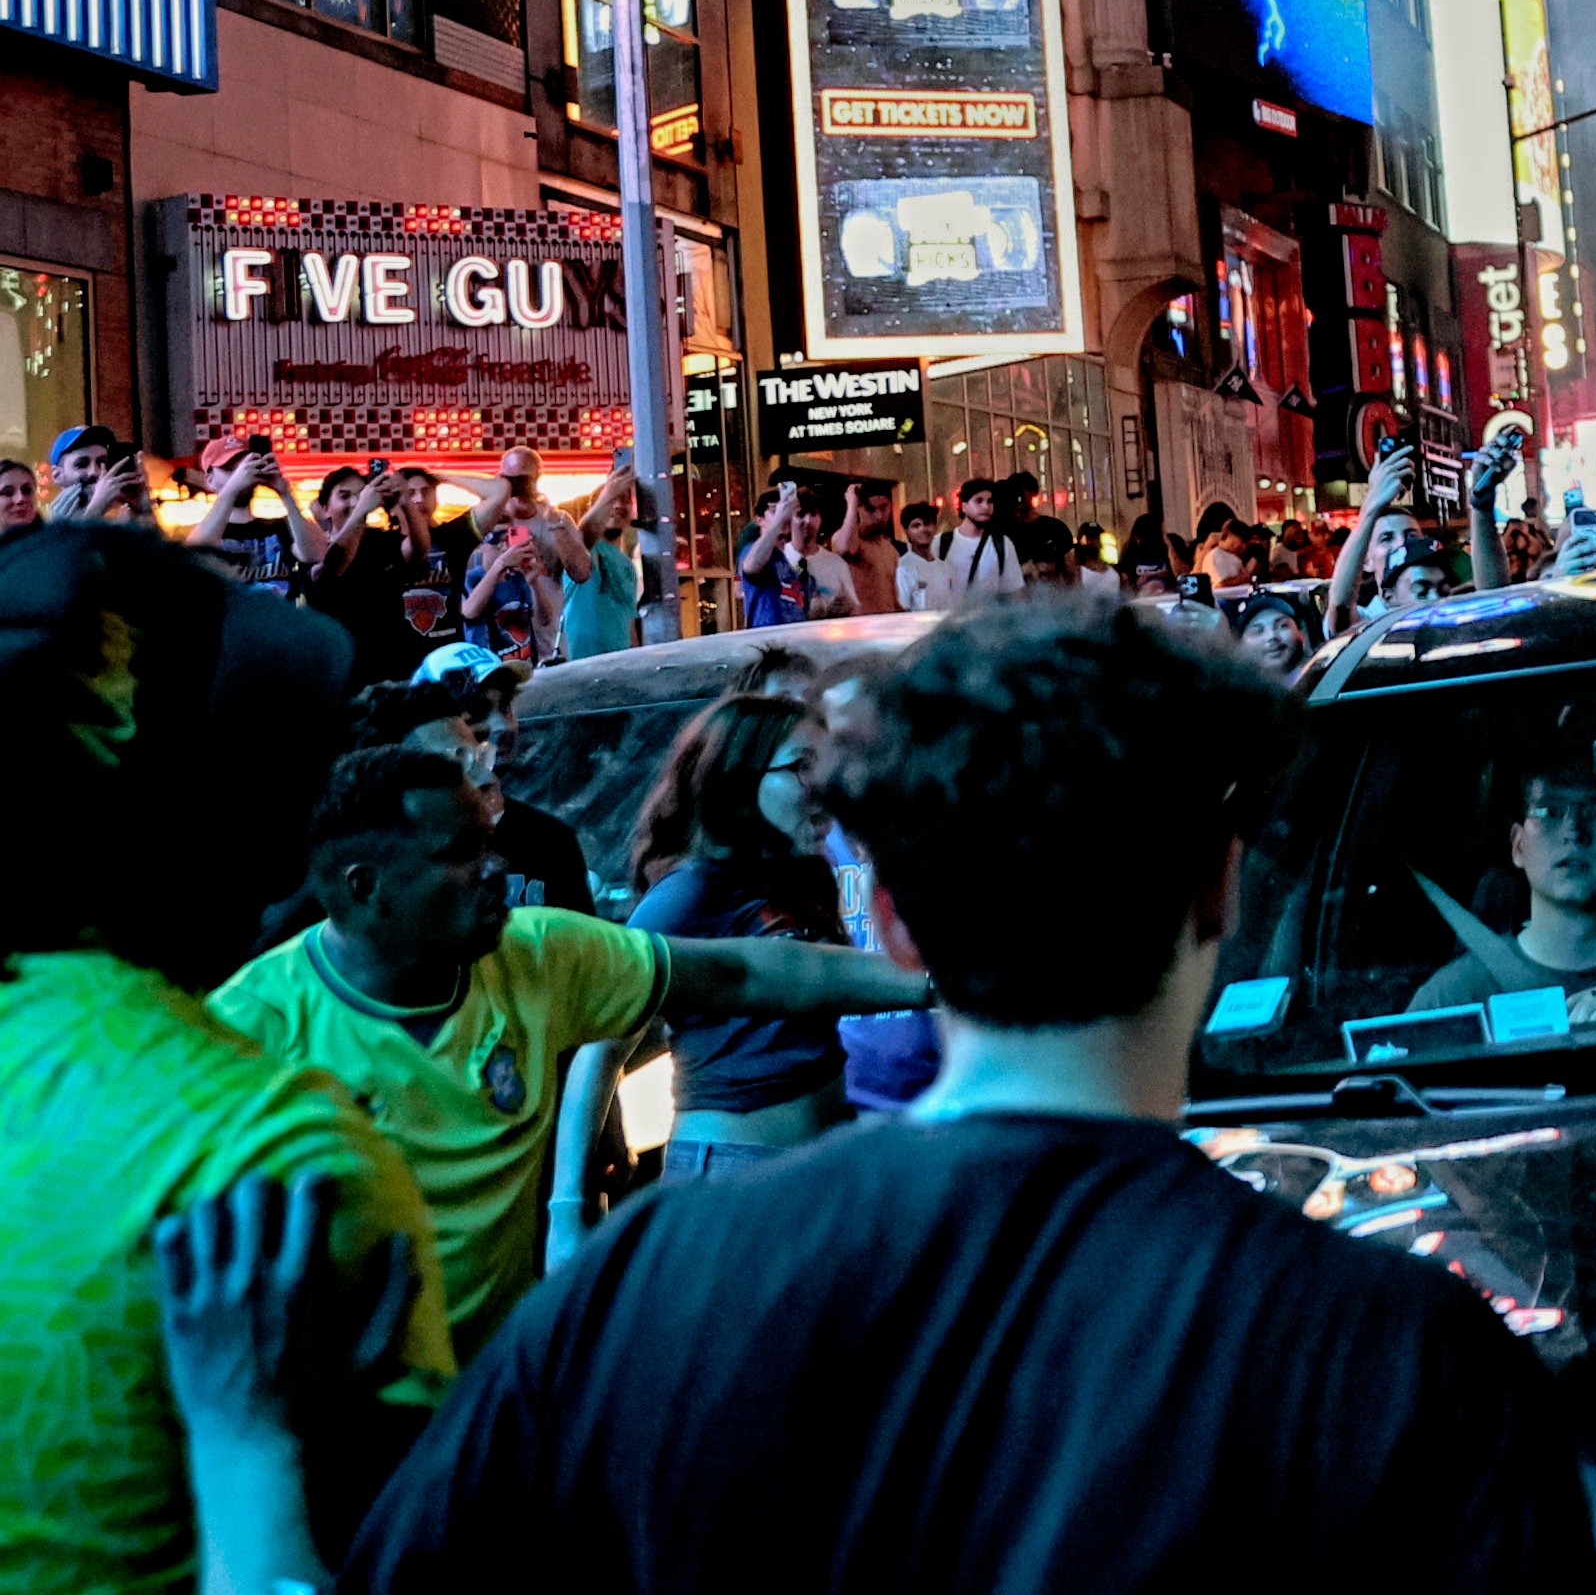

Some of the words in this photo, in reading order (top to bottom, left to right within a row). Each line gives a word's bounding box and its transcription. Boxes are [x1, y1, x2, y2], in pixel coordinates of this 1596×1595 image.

[831, 100, 876, 128] GET
[878, 101, 963, 128] TICKETS
[964, 103, 1027, 128] NOW
[759, 377, 814, 406] THE
[813, 368, 920, 401] WESTIN
[808, 406, 837, 421] NEW
[838, 402, 873, 418] YORK
[788, 424, 806, 440] AT
[806, 421, 844, 438] TIMES
[844, 417, 896, 435] SQUARE
